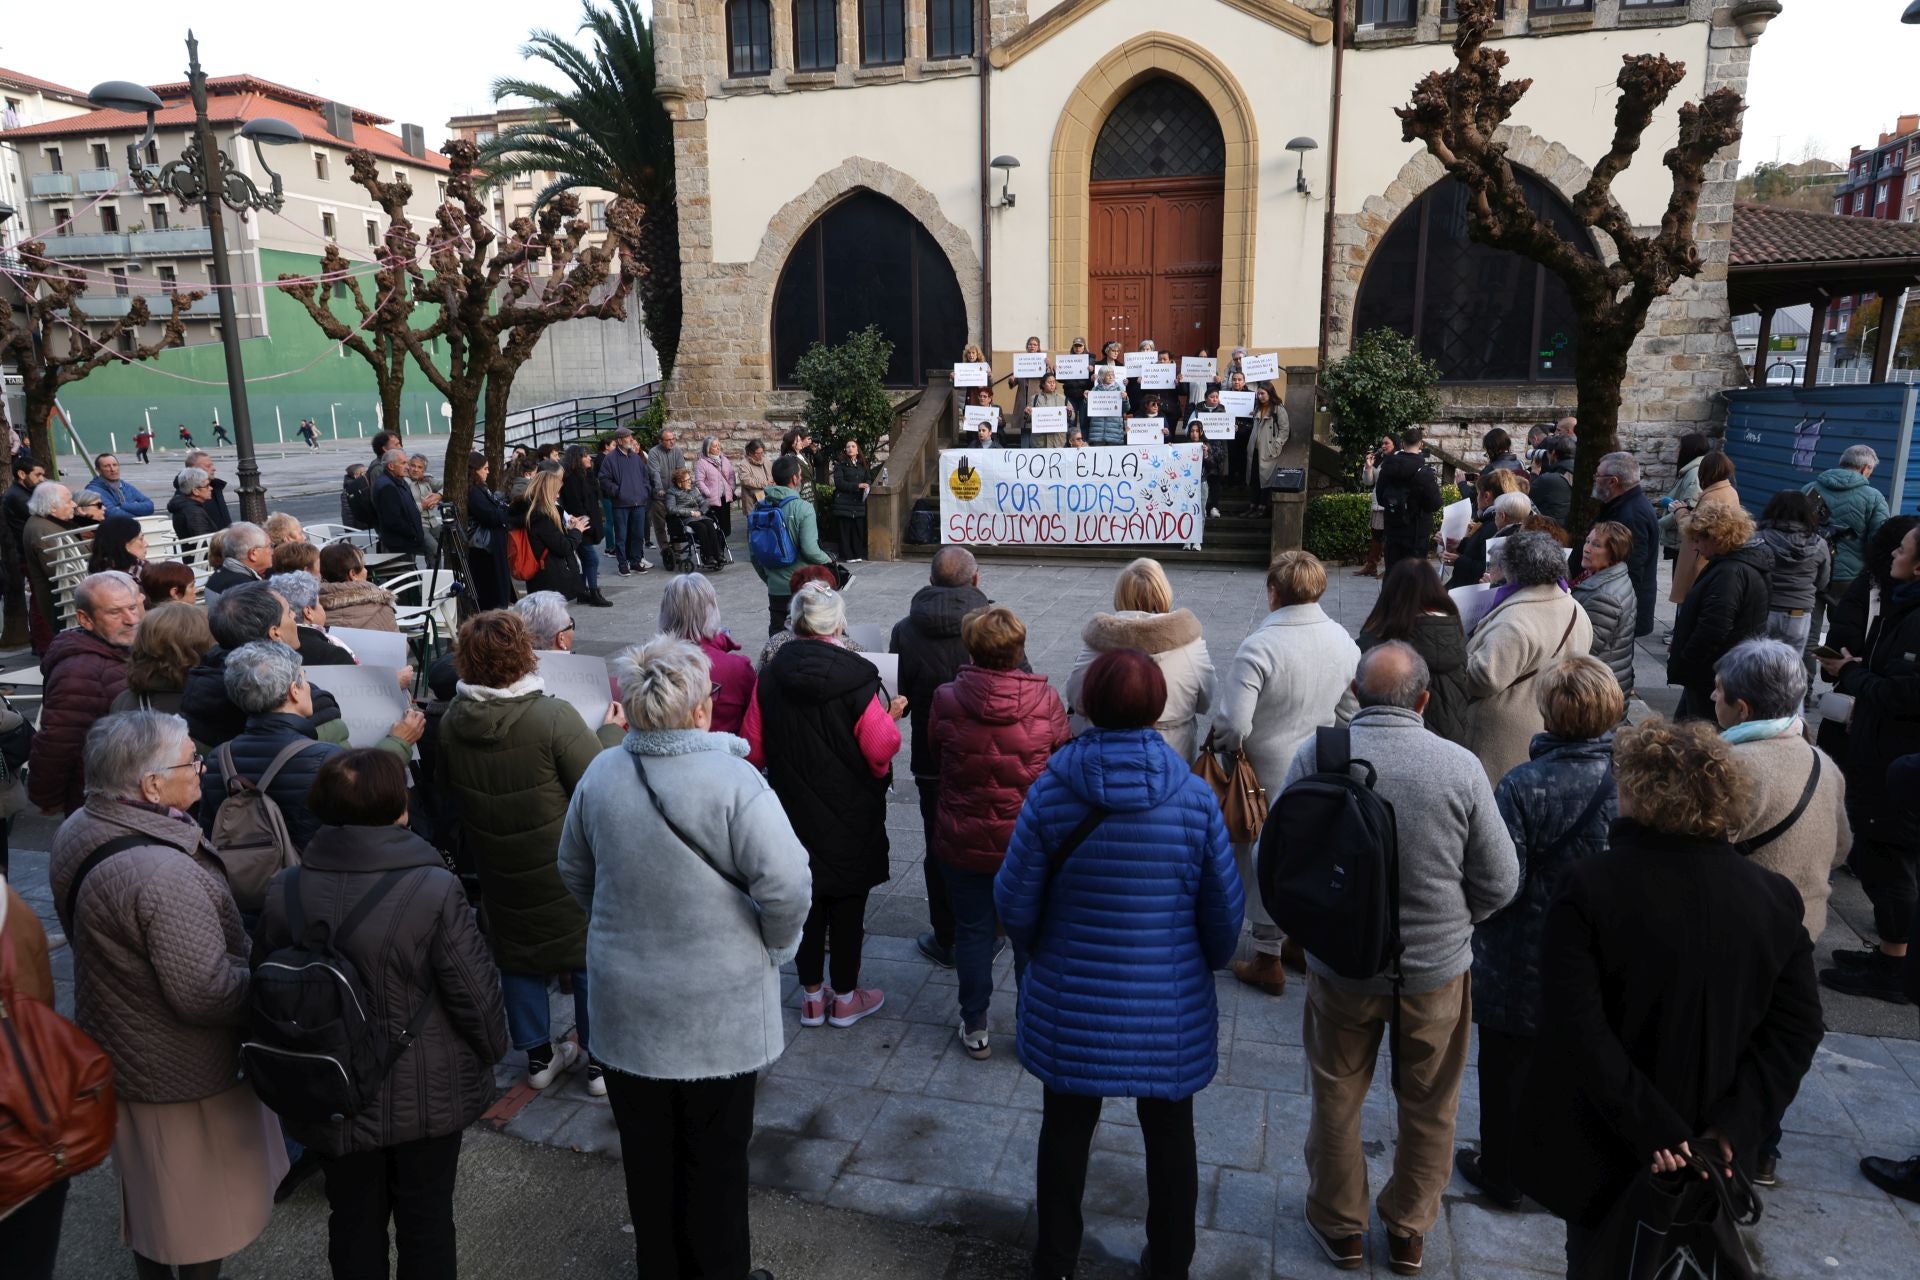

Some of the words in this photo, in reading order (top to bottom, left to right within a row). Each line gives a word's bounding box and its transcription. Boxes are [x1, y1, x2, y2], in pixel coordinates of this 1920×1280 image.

[1077, 451, 1144, 481] ELLA,
[996, 482, 1041, 512] POR
[948, 513, 1066, 543] SEGUIMOS
